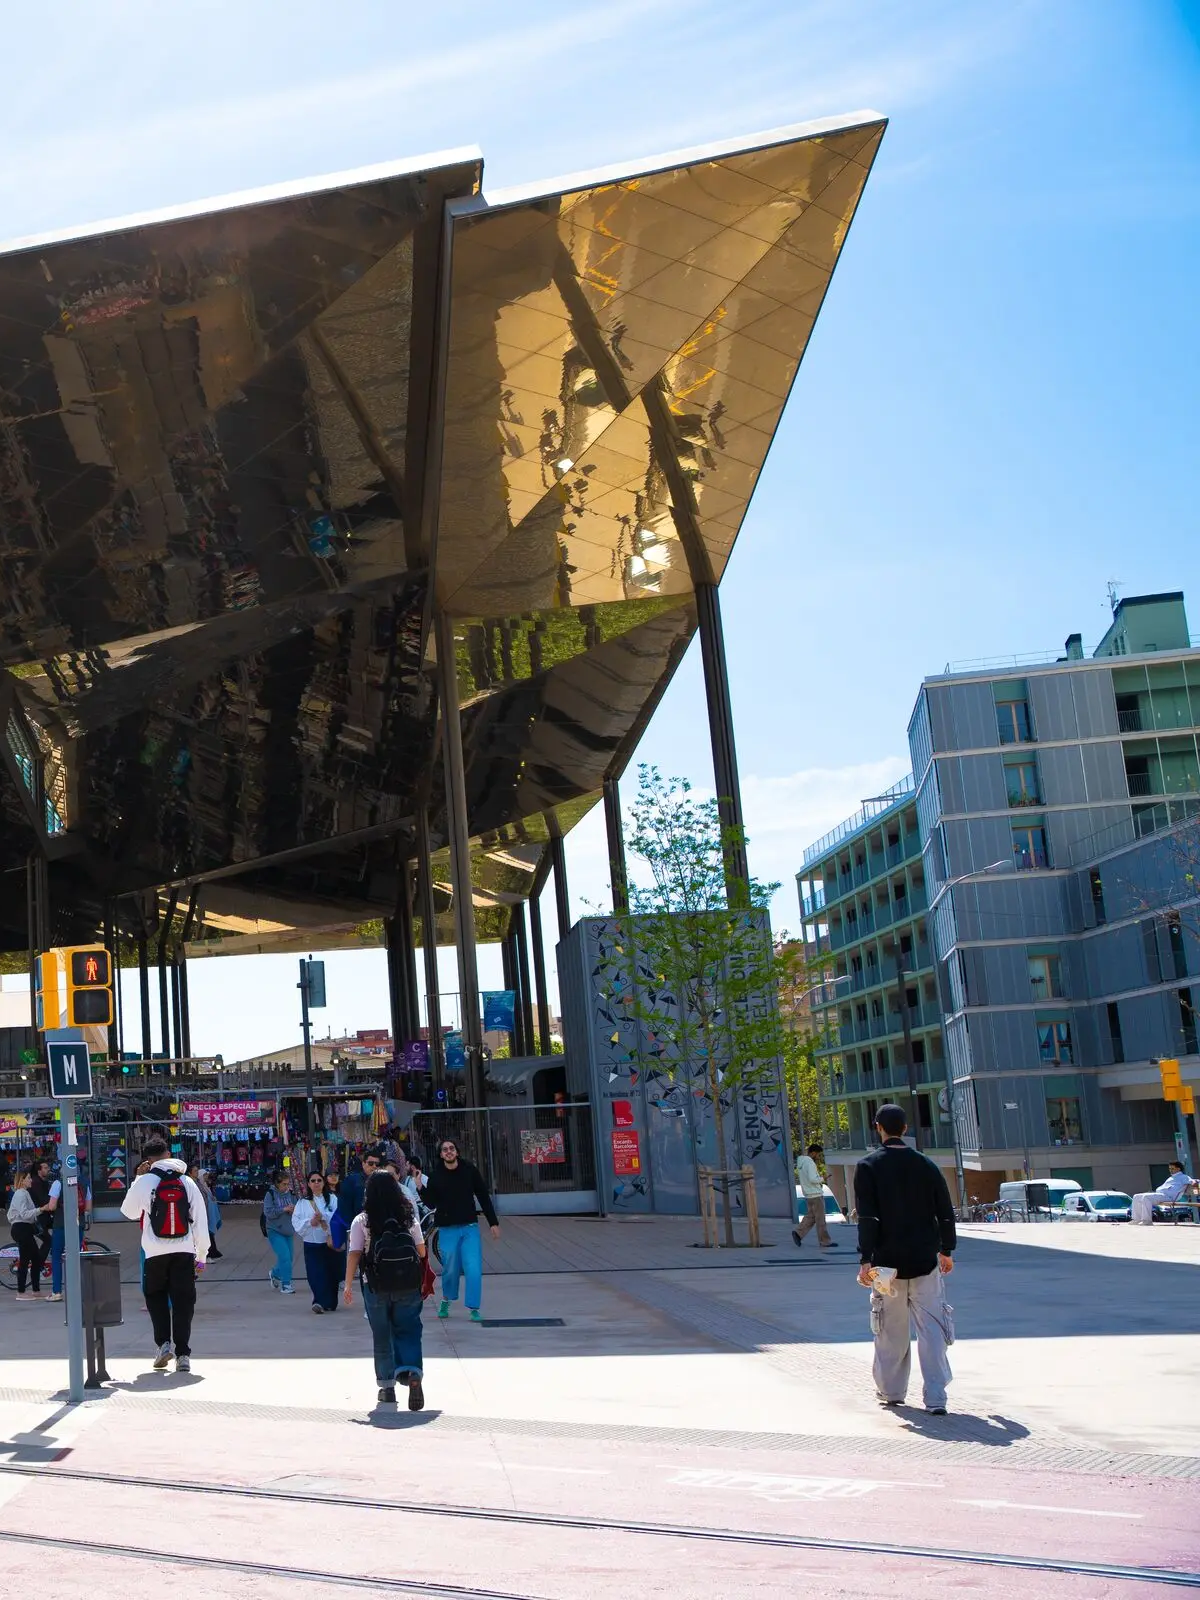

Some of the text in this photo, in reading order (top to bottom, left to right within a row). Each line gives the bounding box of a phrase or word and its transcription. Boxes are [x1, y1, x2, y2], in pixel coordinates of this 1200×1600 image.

[412, 1043, 420, 1052] C
[62, 1054, 78, 1085] M
[437, 1091, 443, 1099] C
[203, 1113, 211, 1122] 5
[223, 1111, 244, 1122] 10€
